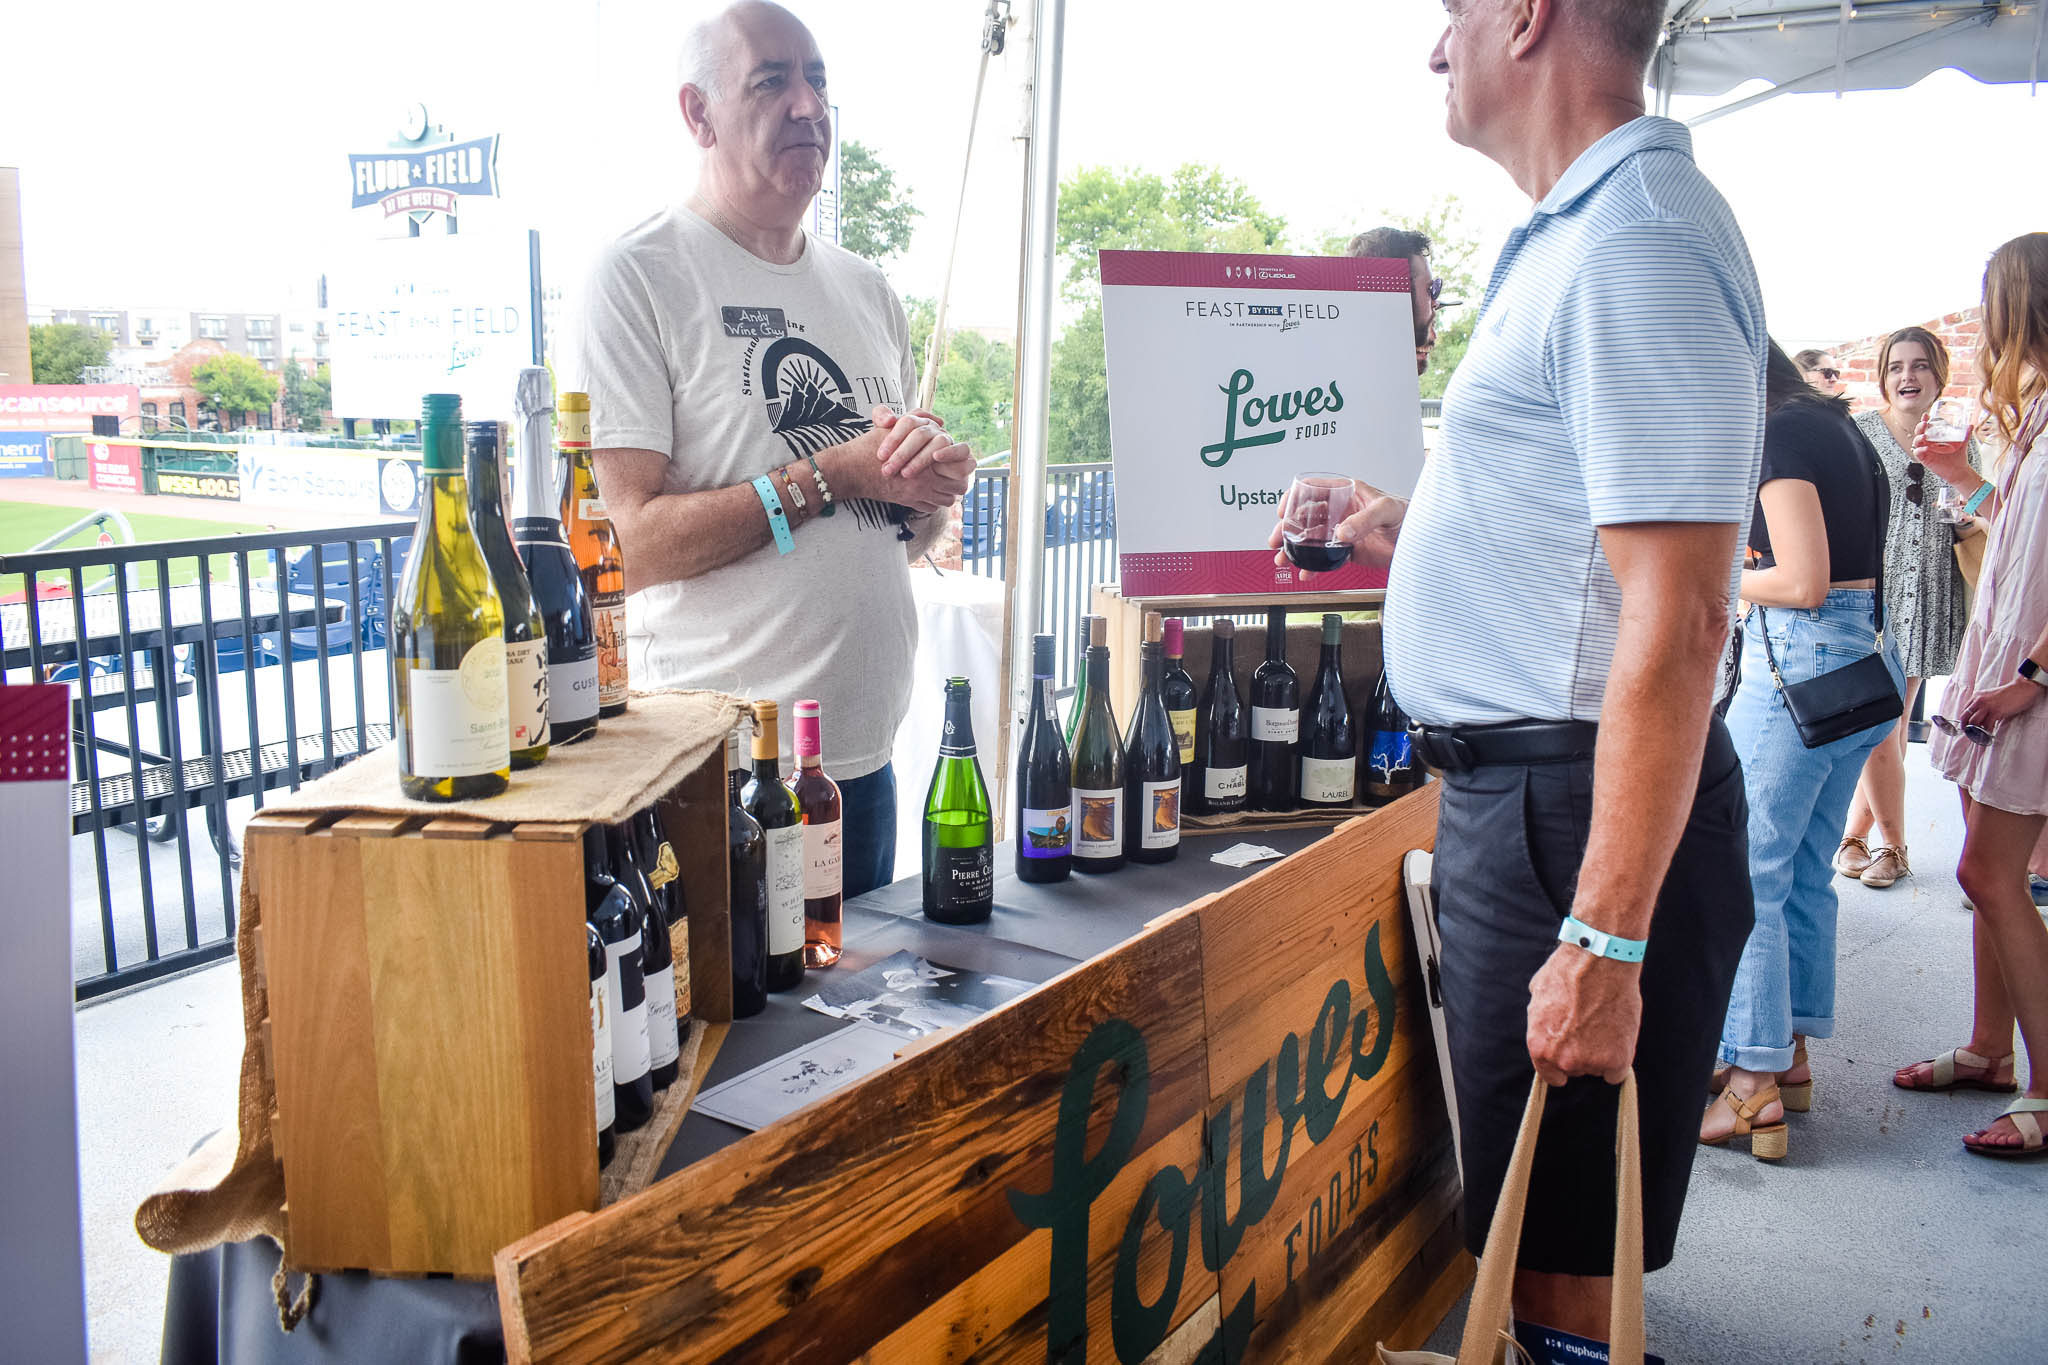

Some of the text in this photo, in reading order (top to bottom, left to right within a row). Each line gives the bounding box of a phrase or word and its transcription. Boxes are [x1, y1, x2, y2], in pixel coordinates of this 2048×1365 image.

[355, 147, 482, 196] FLUOR FIELD
[337, 311, 400, 337] FEAST
[452, 306, 519, 334] FIELD
[739, 309, 769, 325] Andy
[1186, 301, 1245, 318] FEAST
[1287, 303, 1340, 320] FIELD
[724, 322, 785, 338] Wine Guy
[742, 336, 761, 396] Sustainab
[1200, 368, 1344, 468] Lowes
[1295, 420, 1337, 440] FOODS
[1284, 1120, 1379, 1284] FOODS
[1565, 1343, 1609, 1363] euphoria
